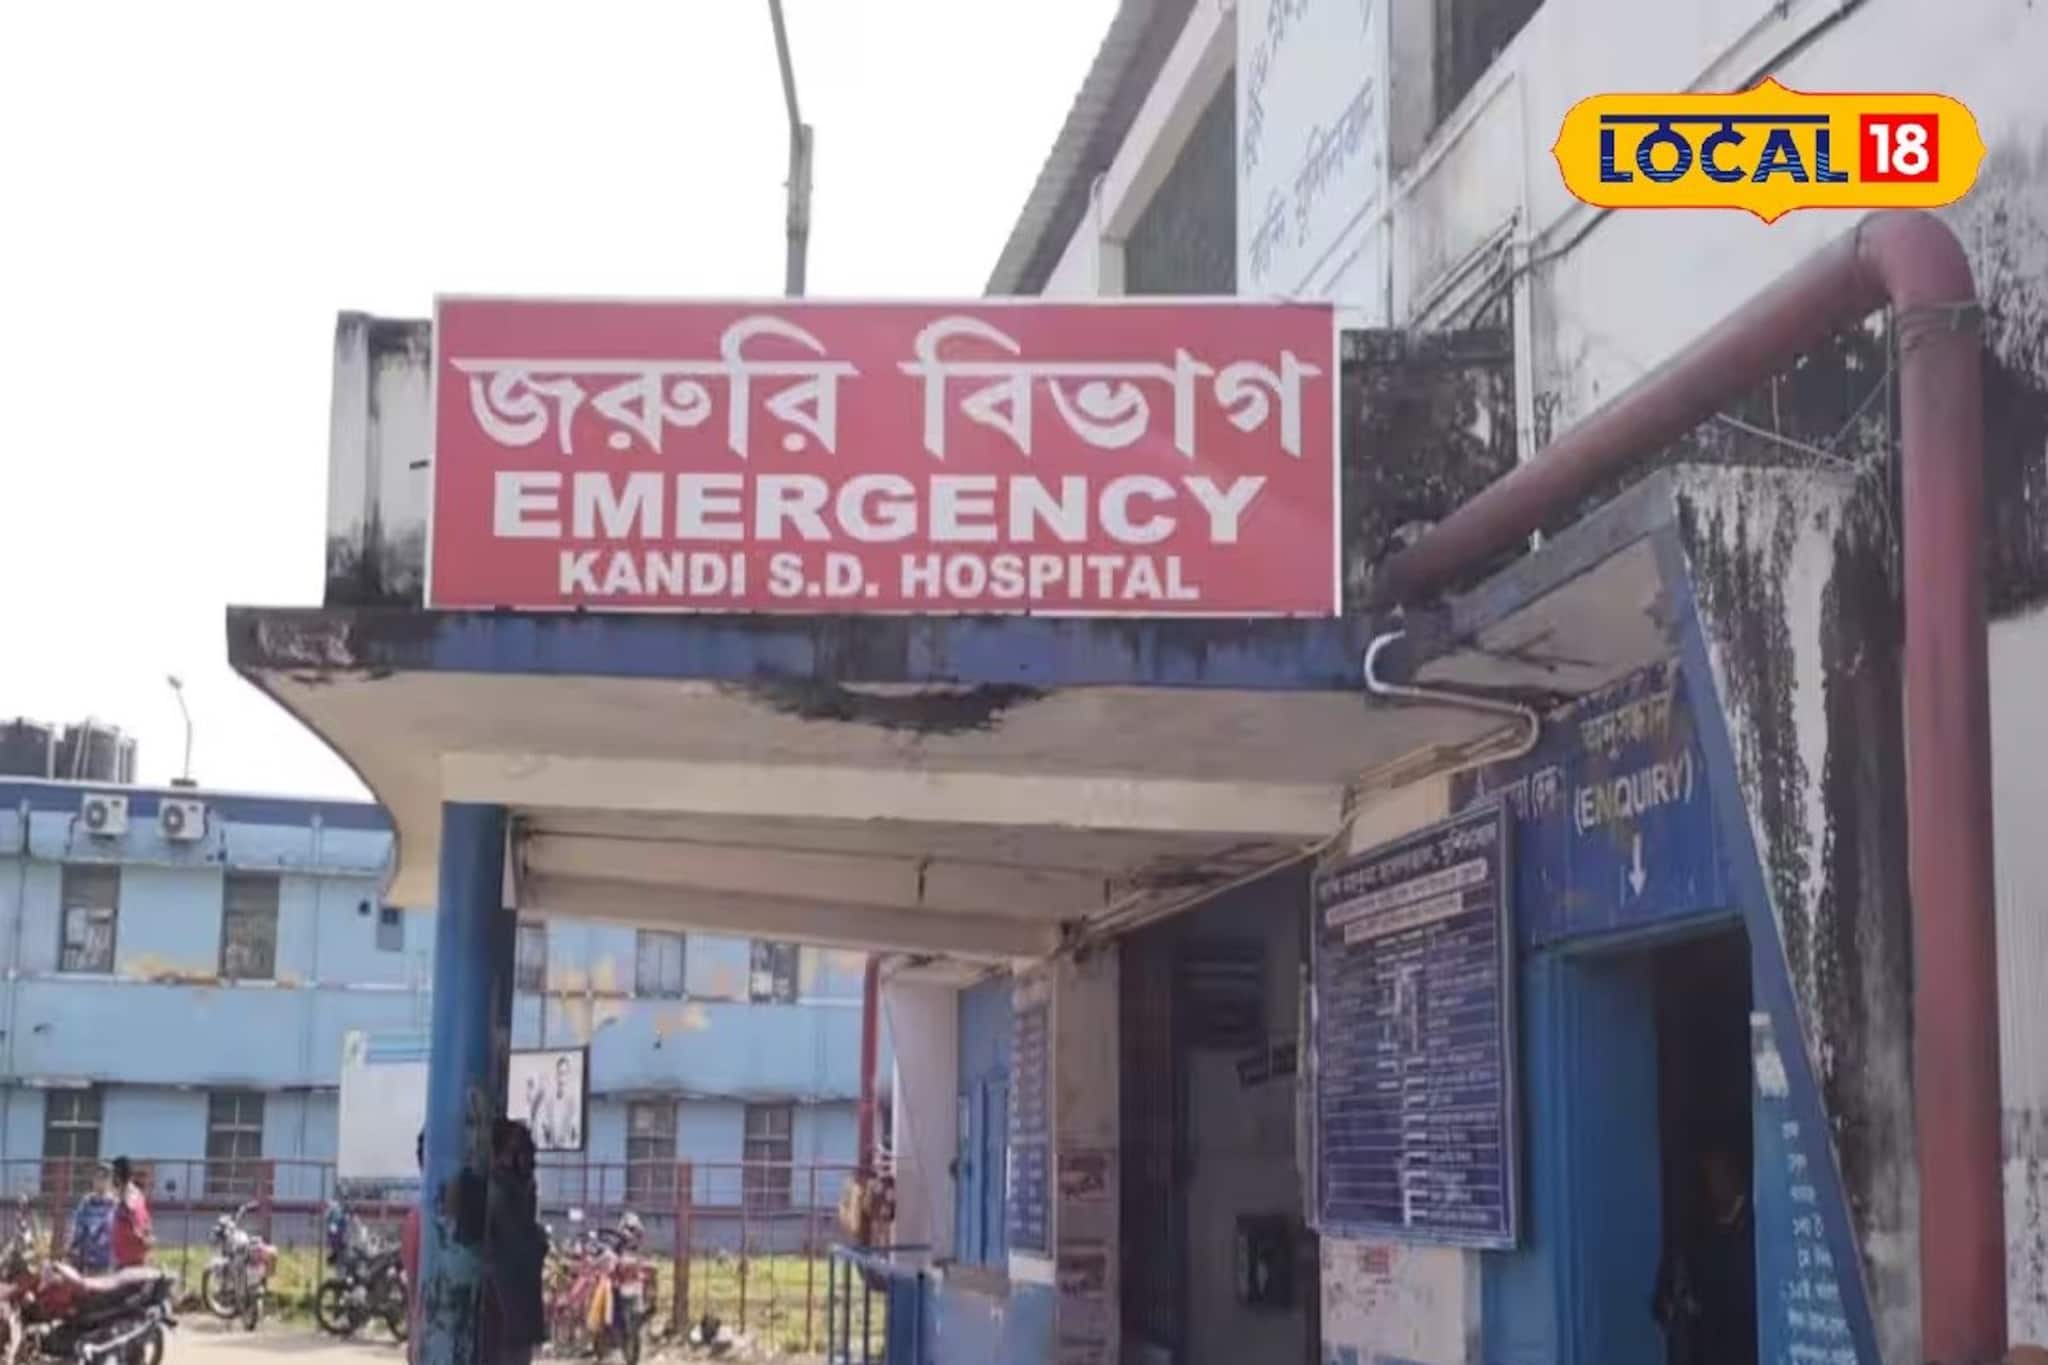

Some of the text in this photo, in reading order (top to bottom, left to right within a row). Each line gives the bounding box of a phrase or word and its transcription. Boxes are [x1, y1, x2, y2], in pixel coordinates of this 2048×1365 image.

[449, 315, 1323, 461] জরুরি বিভাগ
[493, 470, 1267, 545] EMERGENCY
[559, 549, 1199, 600] KANDI S.D. HOSPITAL
[1574, 748, 1693, 836] (ENQUIRY)
